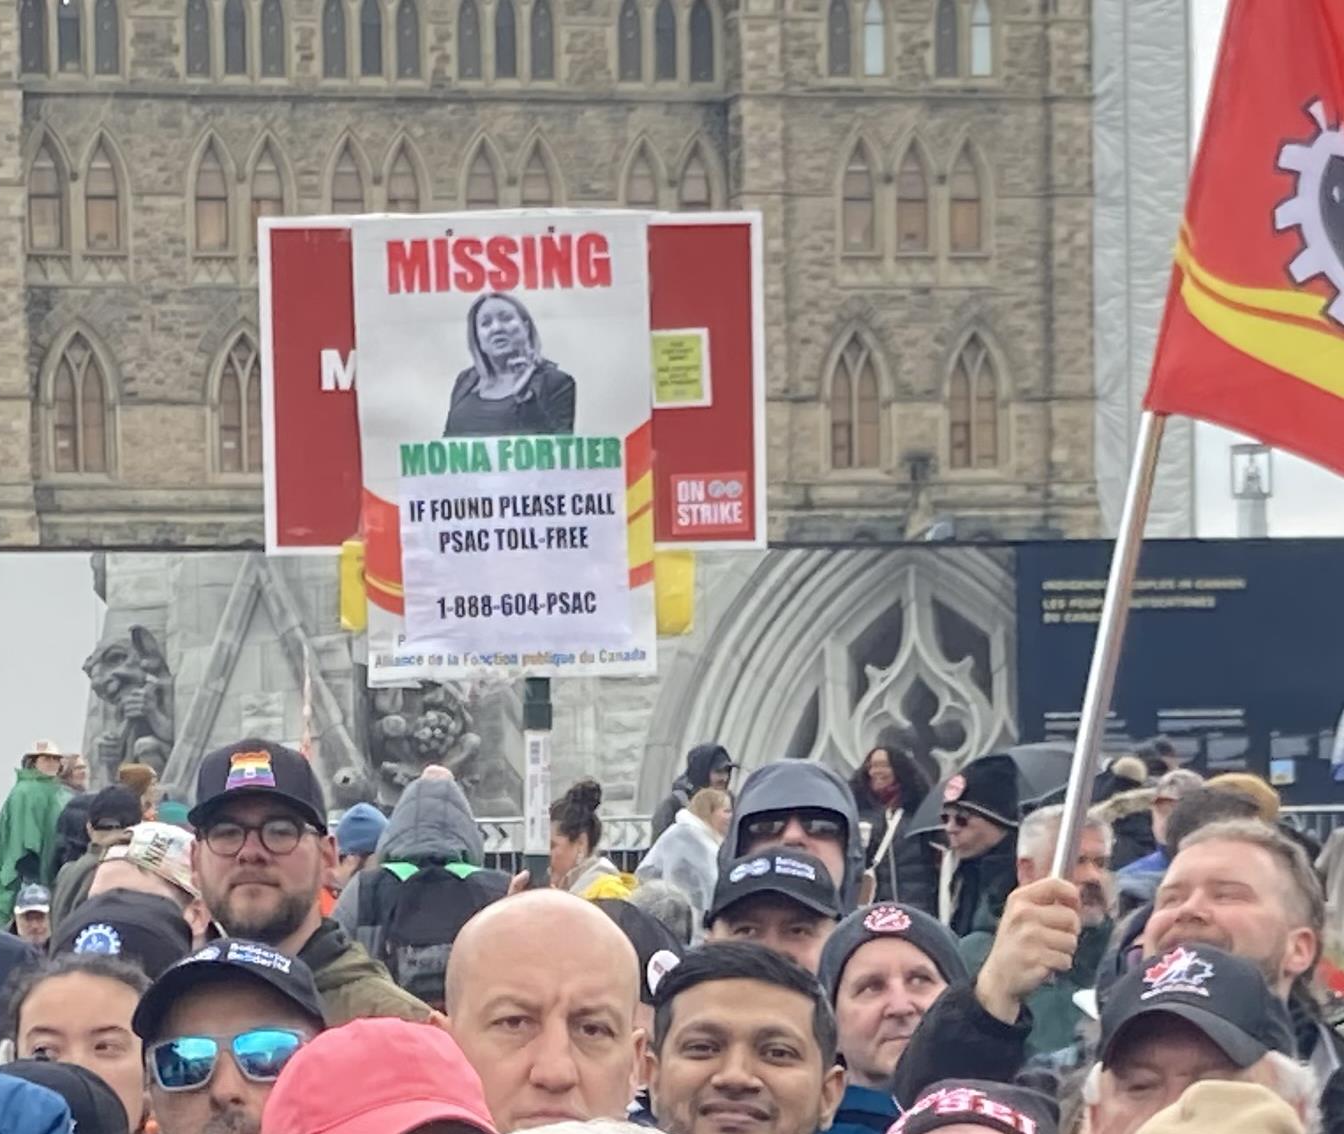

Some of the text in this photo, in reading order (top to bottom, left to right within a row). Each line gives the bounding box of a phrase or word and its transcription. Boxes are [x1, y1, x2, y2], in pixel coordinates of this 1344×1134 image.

[386, 232, 613, 294] MISSING
[400, 437, 622, 476] MONA FORTIER
[677, 480, 704, 502] ON
[409, 493, 615, 522] IF FOUND PLEASE CALL
[677, 501, 743, 526] STRIKE
[439, 526, 589, 553] PSAC TOLL-FREE
[436, 591, 597, 618] 1-888-604-PSAC
[599, 645, 647, 664] Canada
